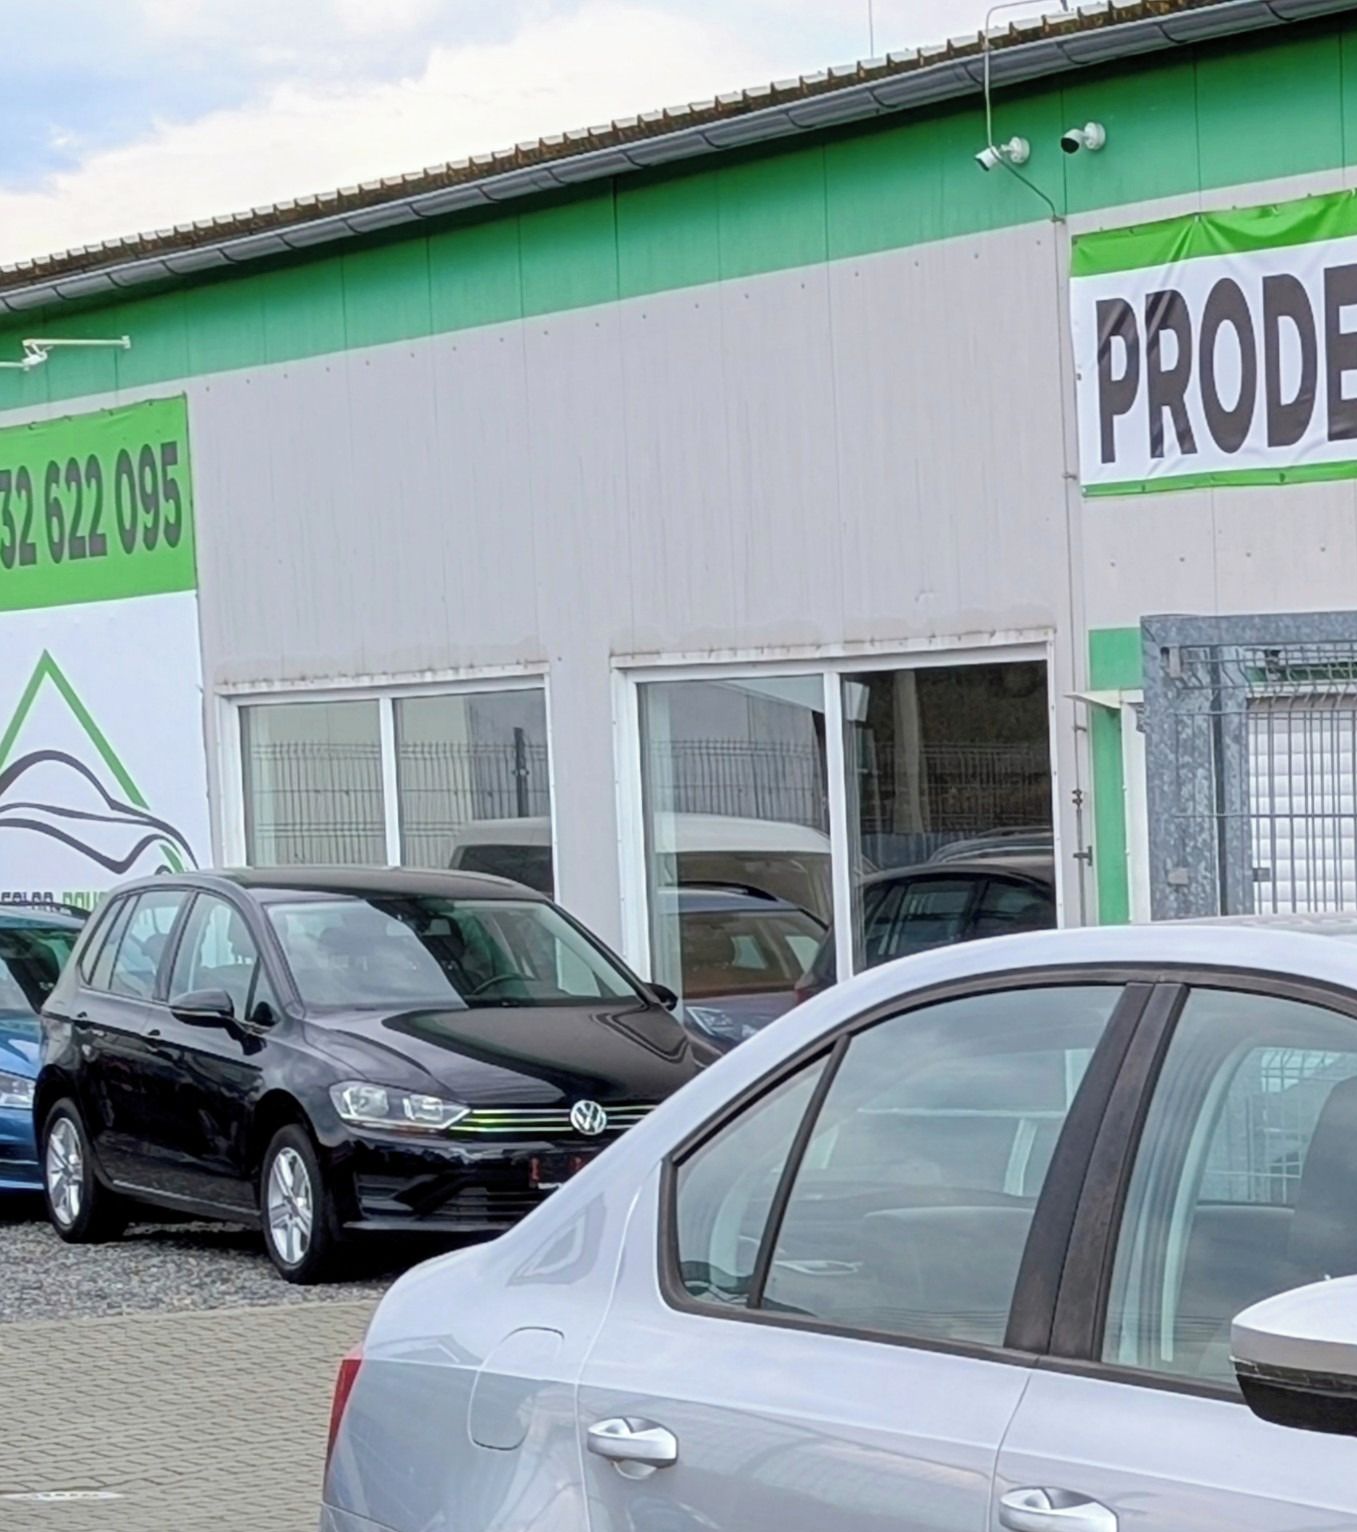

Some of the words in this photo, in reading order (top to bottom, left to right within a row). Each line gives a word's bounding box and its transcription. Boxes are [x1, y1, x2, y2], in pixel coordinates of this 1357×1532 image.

[0, 465, 37, 570] 32
[44, 454, 108, 564] 622
[115, 440, 182, 555] 095
